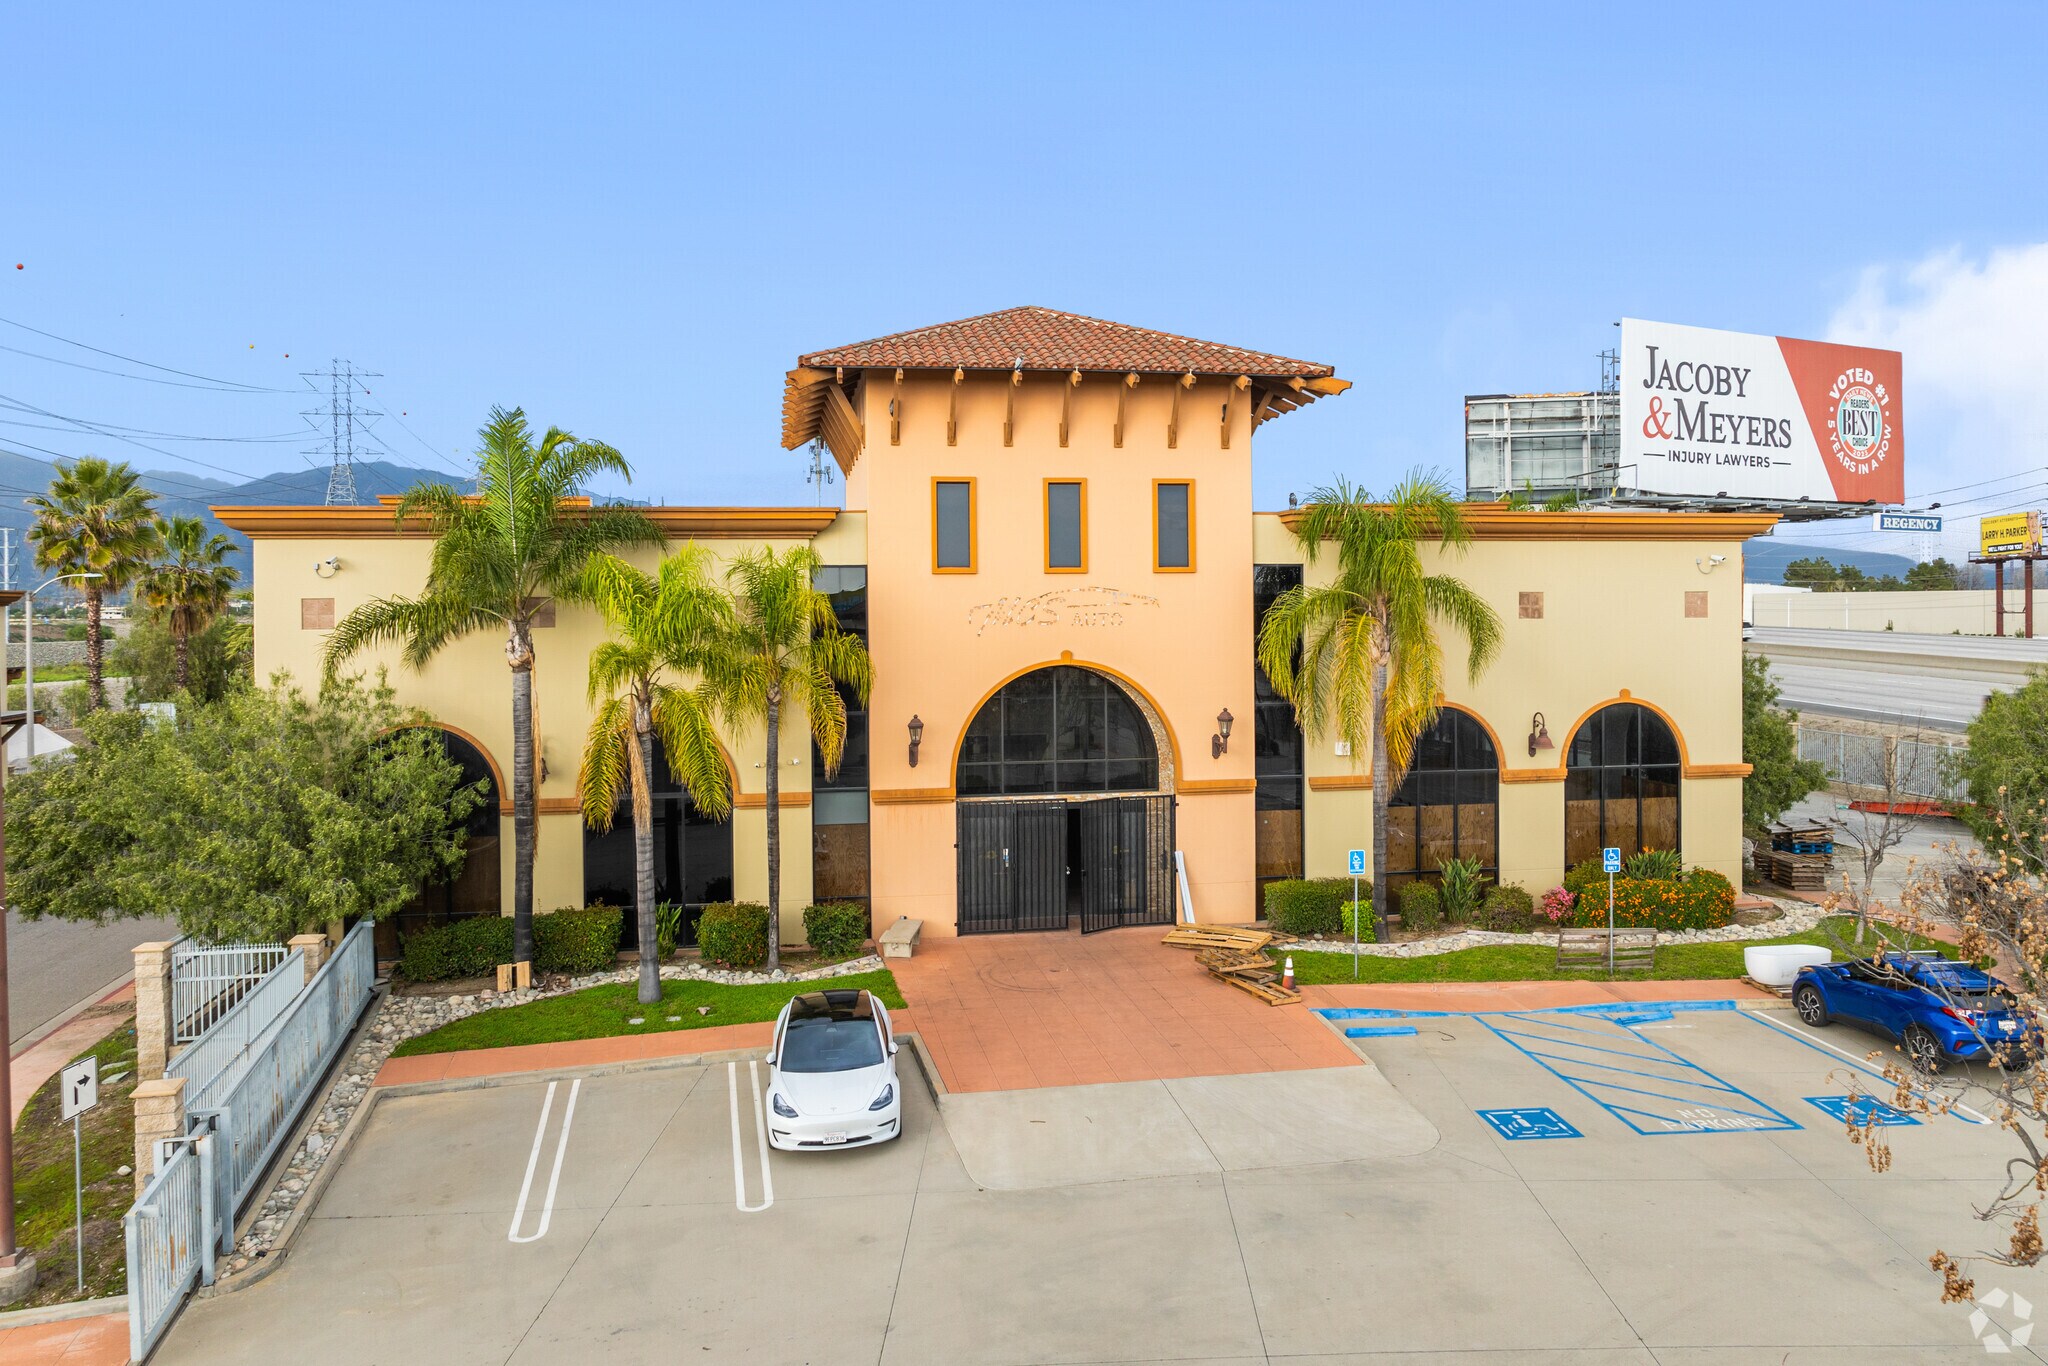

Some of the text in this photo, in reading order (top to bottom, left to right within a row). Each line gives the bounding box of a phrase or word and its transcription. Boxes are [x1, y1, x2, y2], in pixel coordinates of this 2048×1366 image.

[1643, 345, 1751, 397] JACOBY
[1829, 368, 1890, 406] VOTED #1
[1850, 399, 1870, 409] READERS
[1643, 396, 1792, 449] & MEYERS
[1842, 409, 1878, 437] BEST
[1827, 420, 1892, 475] 5 YEARS IN A ROW
[1852, 437, 1868, 447] CHOICE
[1668, 450, 1770, 468] INJURY LAWYERS
[1883, 517, 1939, 530] REGENCY
[1982, 529, 1998, 540] LARRY
[2006, 526, 2028, 538] PARKER
[1676, 1109, 1716, 1119] NO
[1660, 1117, 1765, 1130] PARKING
